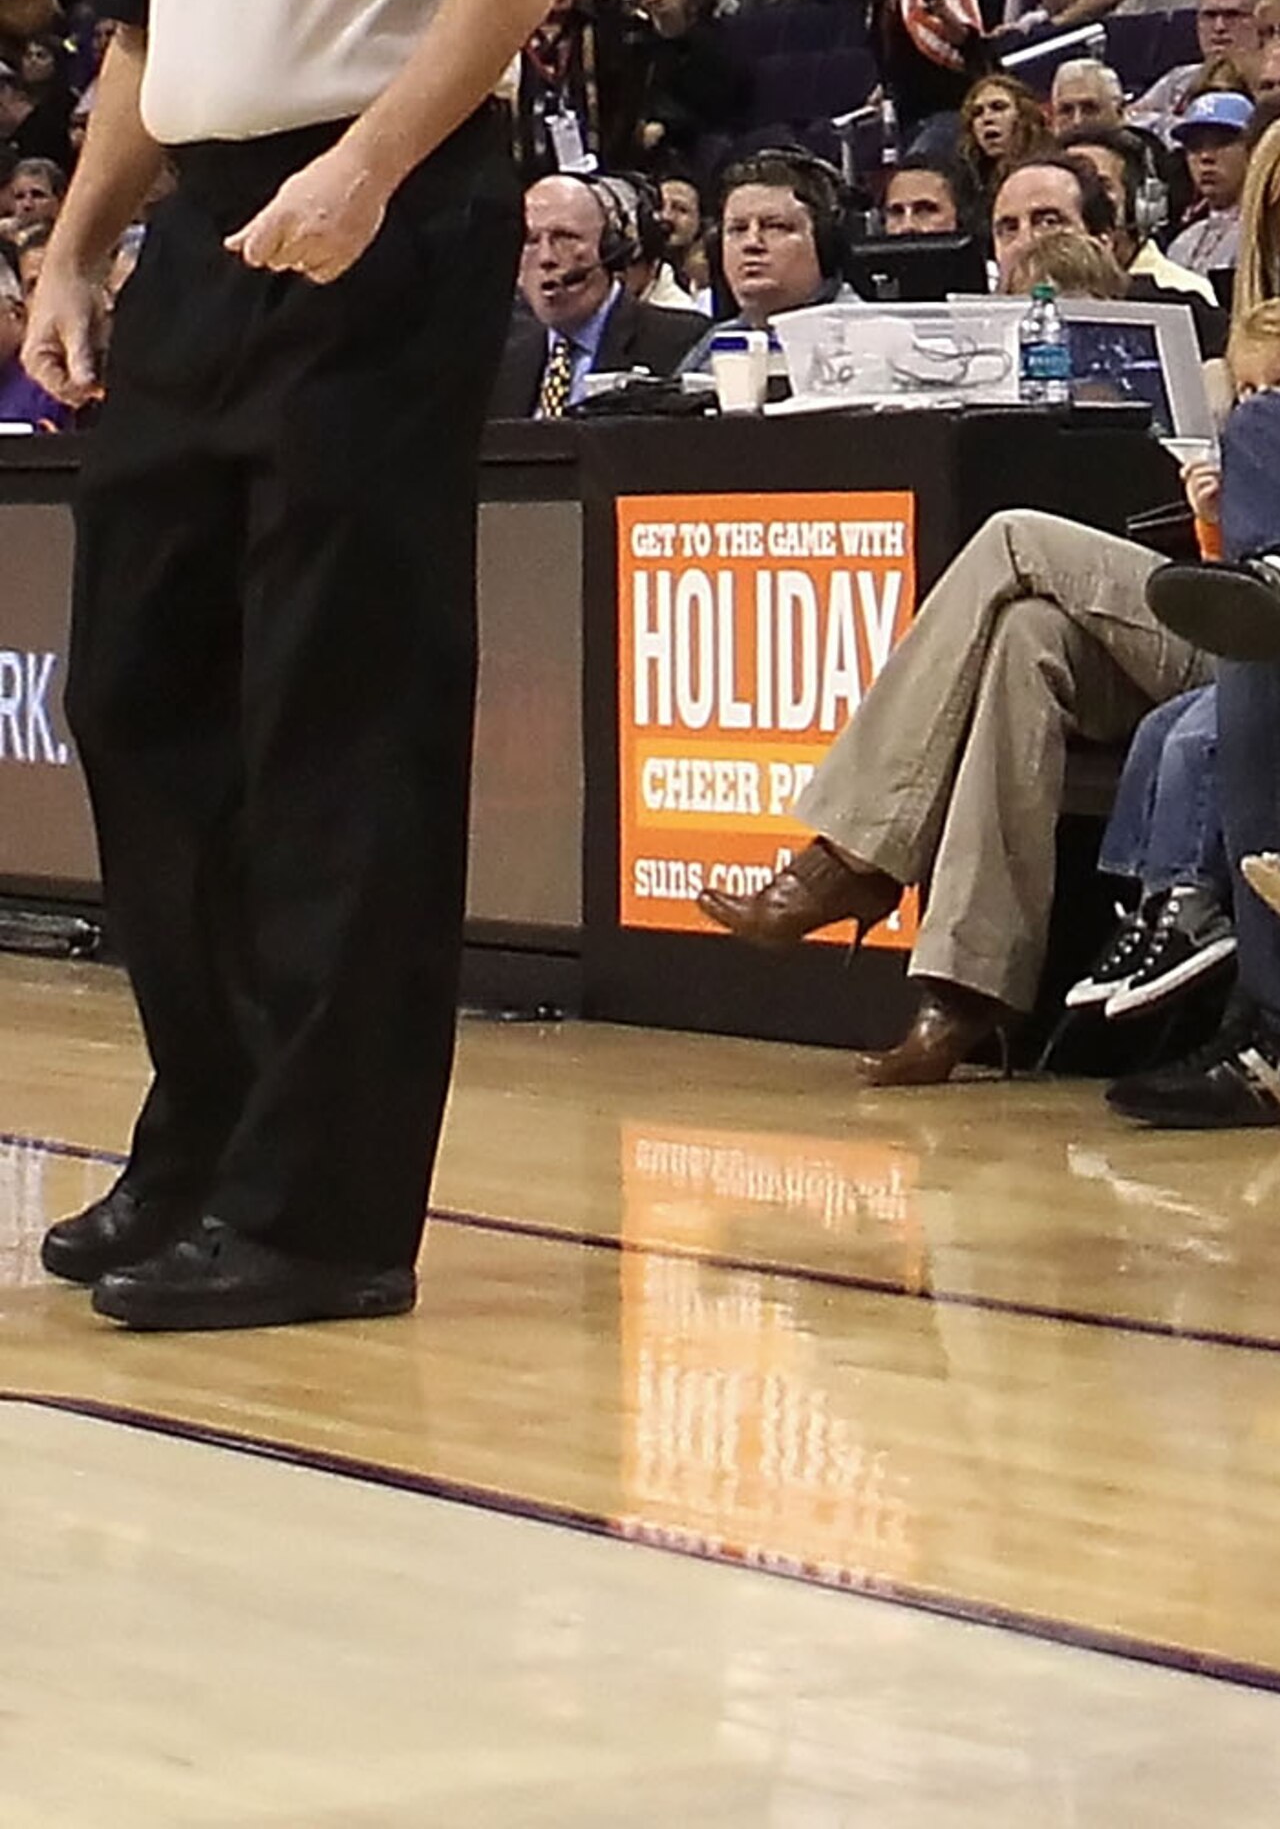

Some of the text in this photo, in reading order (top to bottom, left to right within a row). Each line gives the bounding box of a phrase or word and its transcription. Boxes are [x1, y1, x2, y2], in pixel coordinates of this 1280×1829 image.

[631, 520, 905, 558] GET TO THE GAME WITH
[632, 568, 903, 732] HOLIDAY
[641, 757, 762, 815] CHEER
